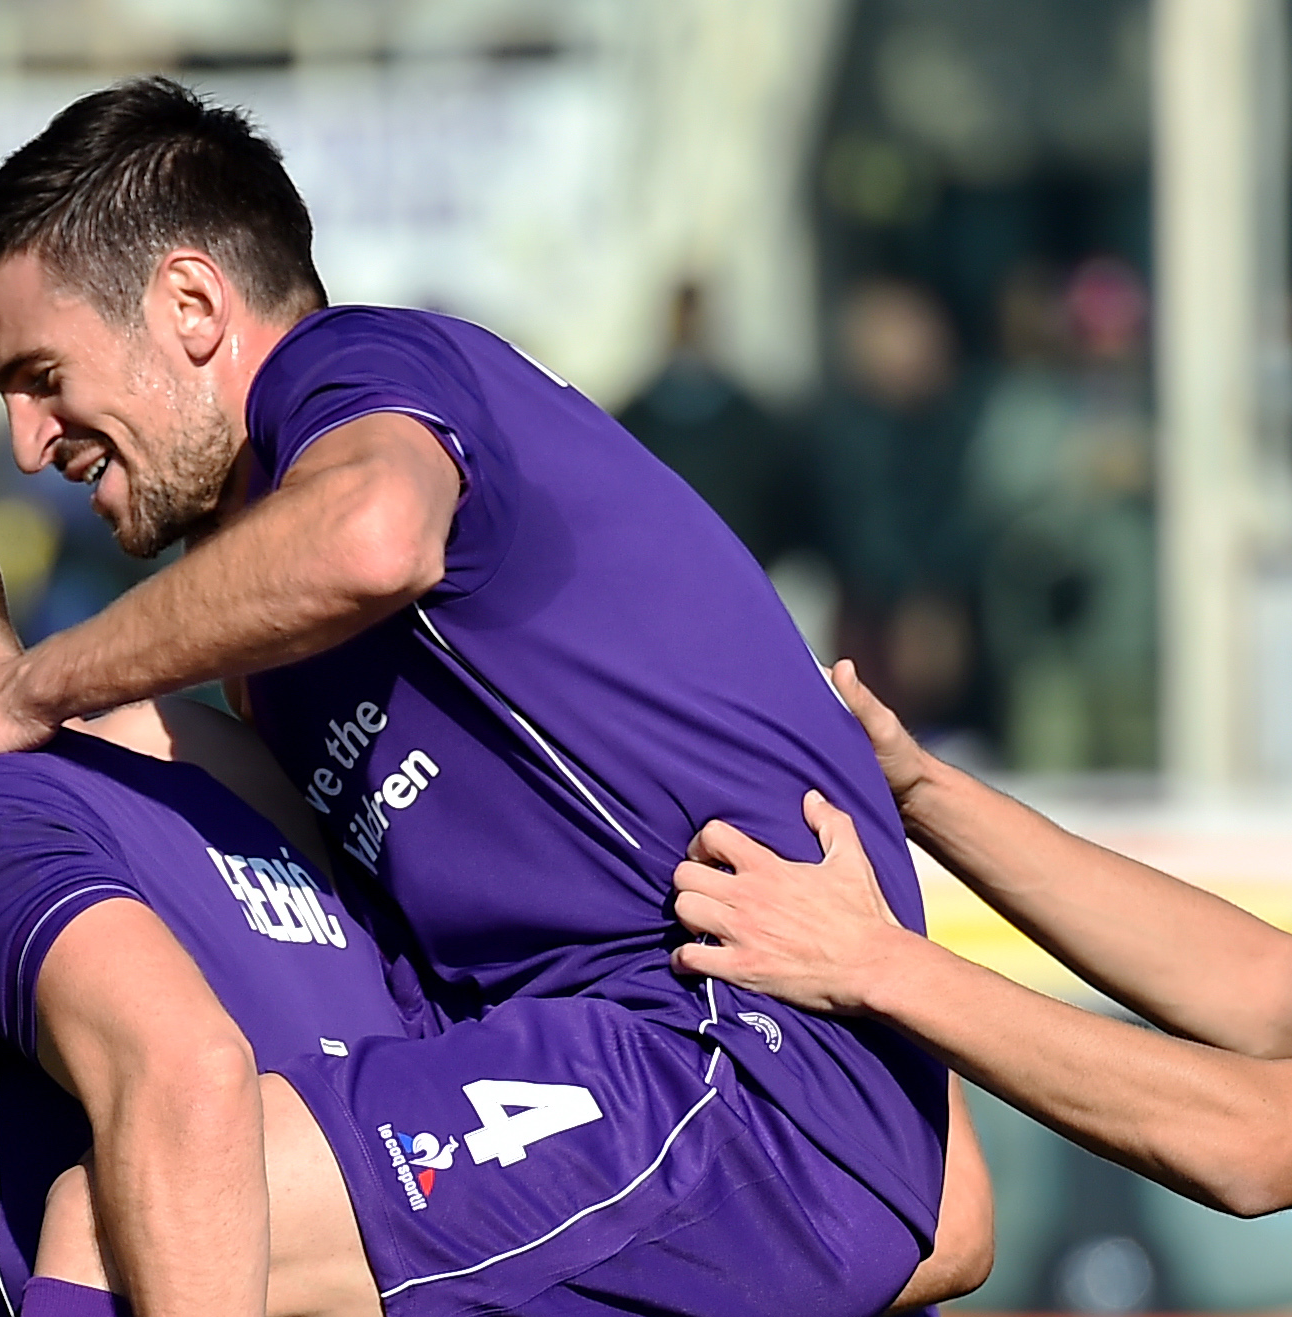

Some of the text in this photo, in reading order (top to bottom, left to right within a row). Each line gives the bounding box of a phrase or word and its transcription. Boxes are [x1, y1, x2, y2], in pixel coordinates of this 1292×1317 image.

[325, 701, 388, 770] the
[462, 1077, 604, 1168] 4
[377, 1123, 428, 1211] le coq sportif
